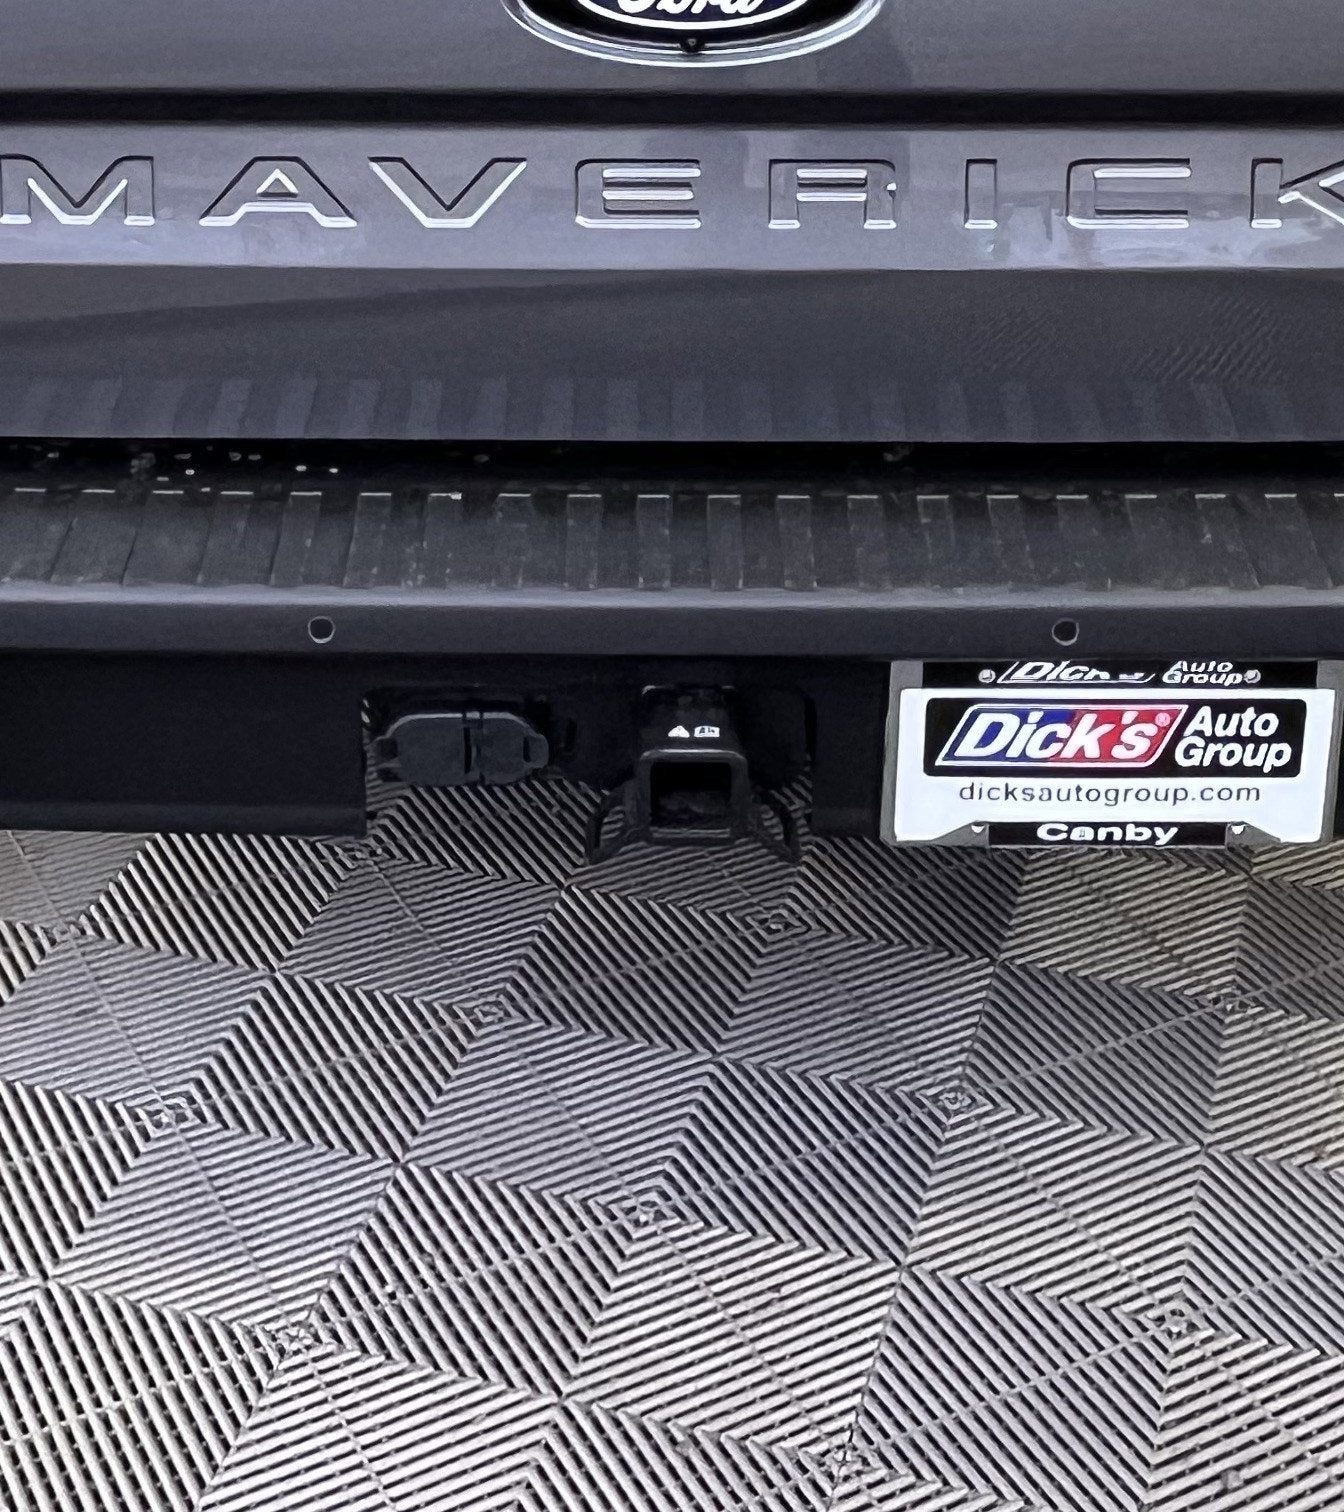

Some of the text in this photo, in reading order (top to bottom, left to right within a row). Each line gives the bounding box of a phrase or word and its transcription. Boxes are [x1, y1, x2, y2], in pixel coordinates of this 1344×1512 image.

[1162, 672, 1244, 687] Group
[954, 710, 1158, 760] Dick's
[1183, 705, 1280, 738] Auto
[1174, 735, 1293, 774] Group
[959, 781, 1261, 807] dicksautogroup.com
[1036, 822, 1179, 846] Canby
